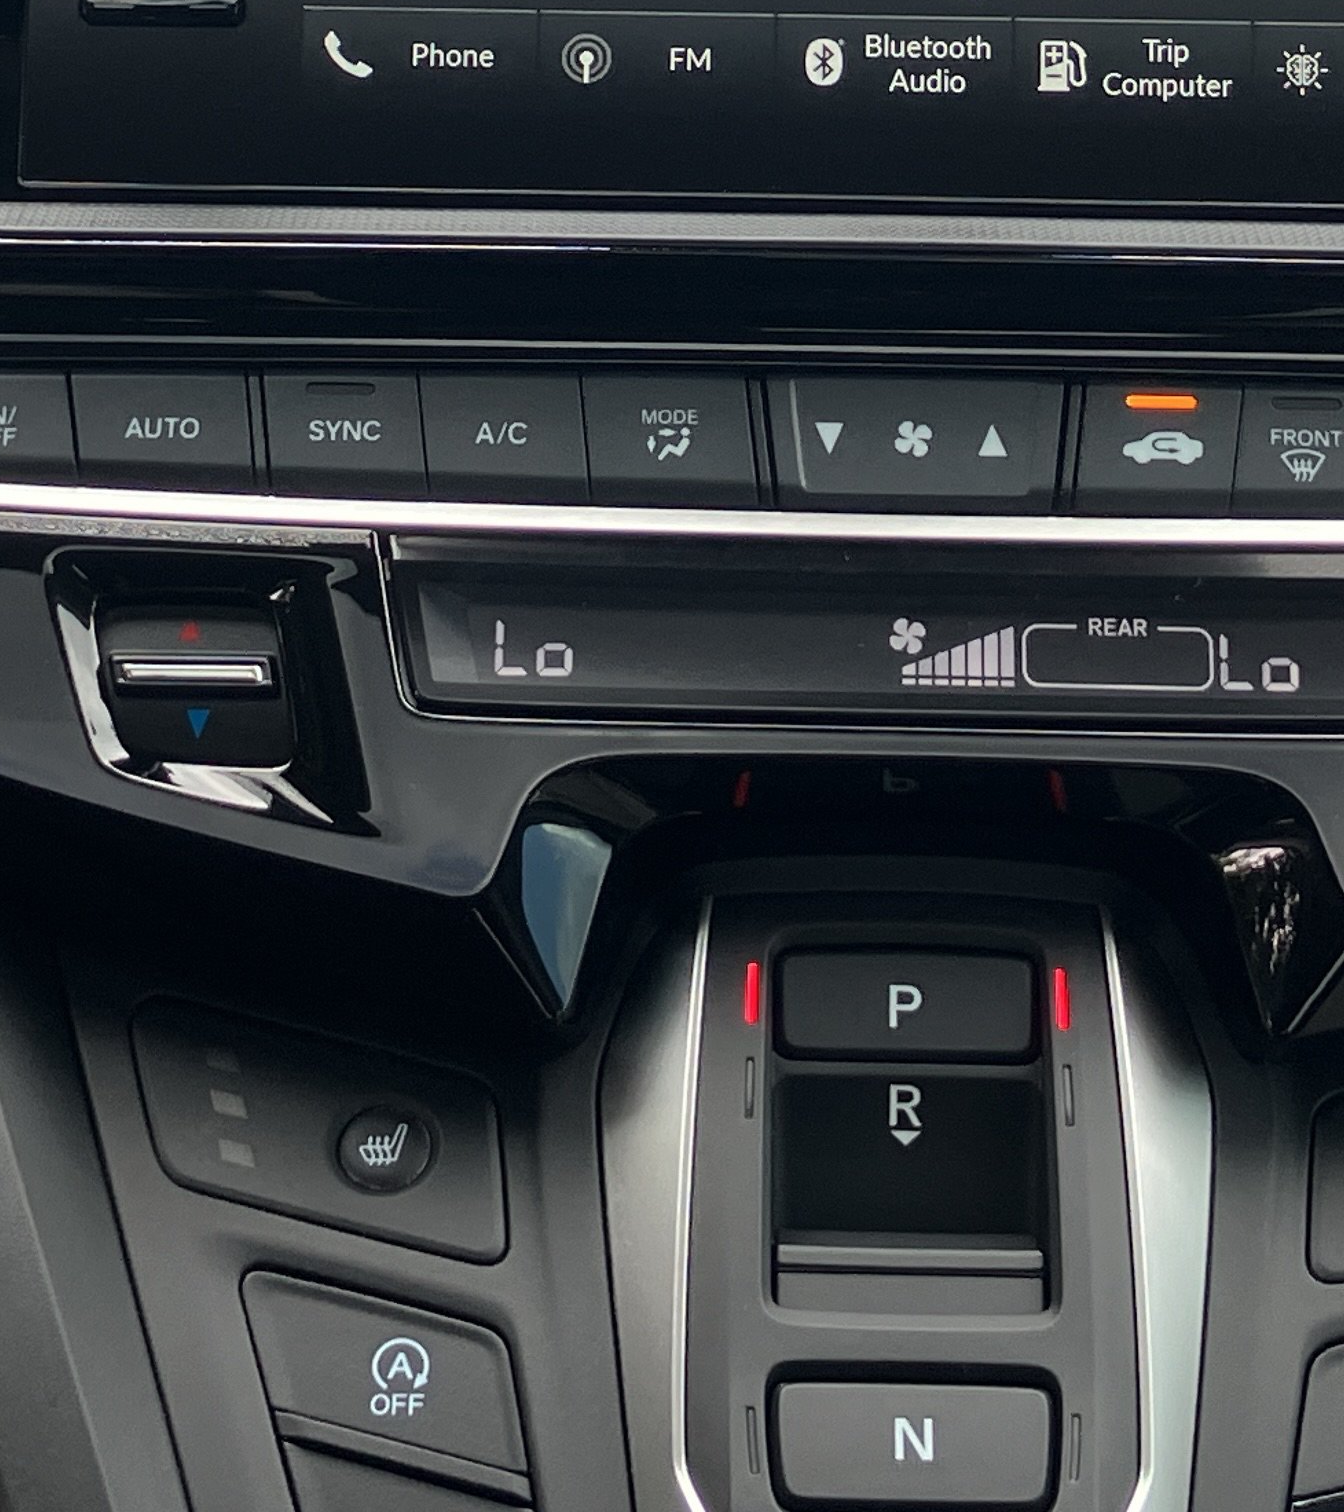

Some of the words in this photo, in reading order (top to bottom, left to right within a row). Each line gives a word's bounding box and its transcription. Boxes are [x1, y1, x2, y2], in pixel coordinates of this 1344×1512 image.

[412, 42, 494, 68] Phone
[669, 47, 711, 71] FM
[865, 33, 992, 60] Bluetooth
[1141, 38, 1190, 69] Trip
[888, 68, 966, 93] Audio
[1102, 72, 1233, 103] Computer
[124, 417, 200, 439] AUTO
[308, 419, 381, 441] SYNC
[641, 409, 699, 426] MODE
[475, 422, 528, 445] A/C
[1270, 428, 1343, 449] FRONT
[1088, 617, 1148, 637] REAR
[494, 619, 574, 678] Lo
[1219, 633, 1300, 693] Lo
[888, 984, 923, 1029] P
[888, 1083, 922, 1127] R
[370, 1393, 425, 1416] OFF
[894, 1417, 934, 1462] N
